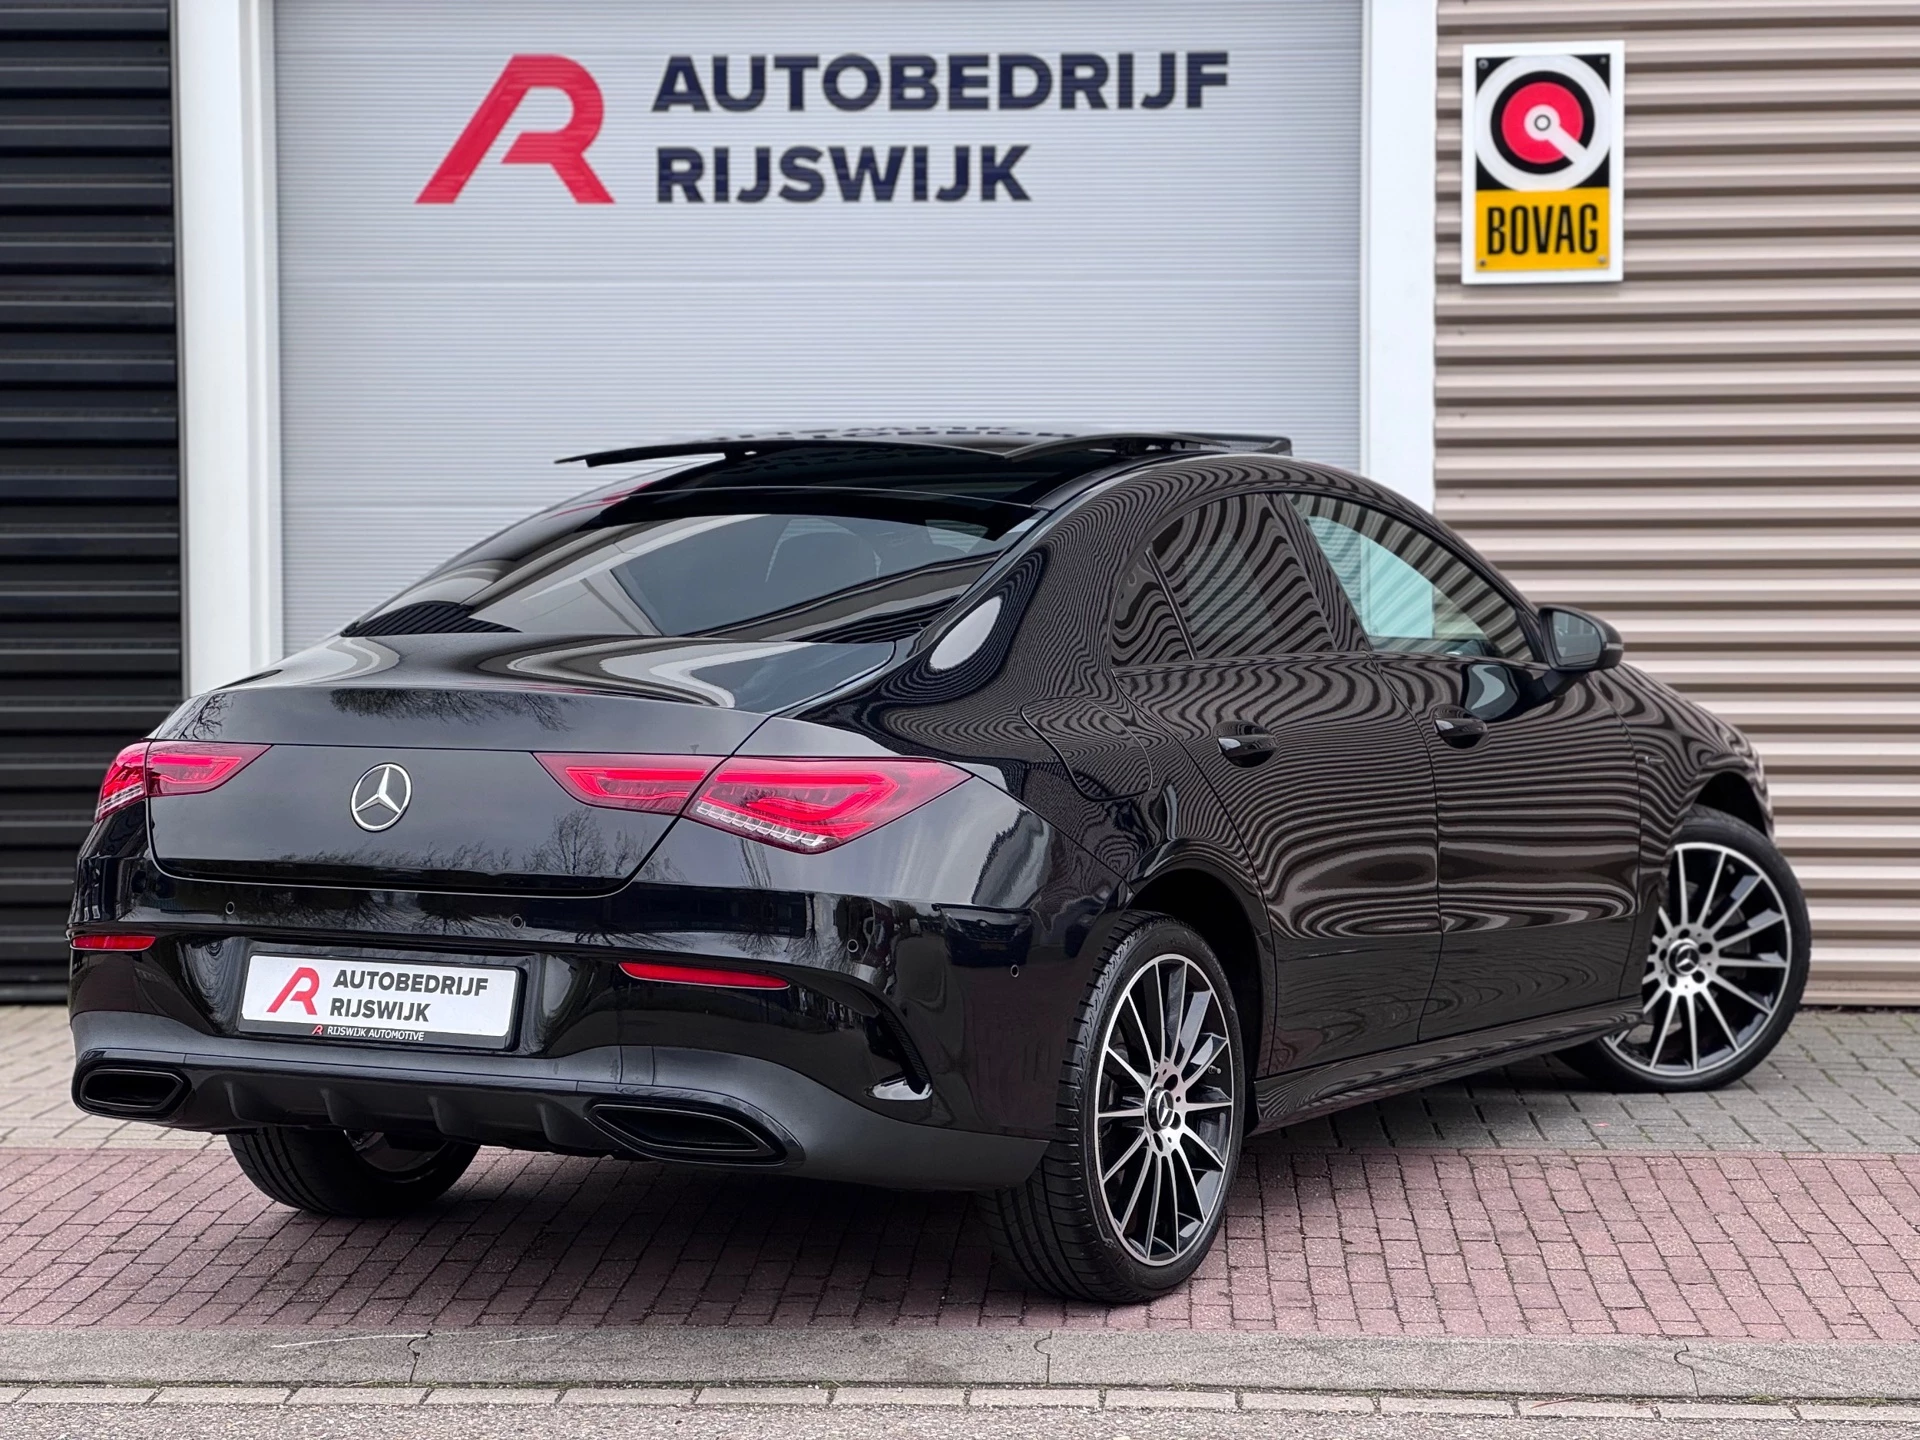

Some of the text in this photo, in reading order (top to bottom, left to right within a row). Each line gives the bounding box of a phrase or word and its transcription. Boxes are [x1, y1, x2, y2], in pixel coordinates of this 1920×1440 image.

[651, 51, 1230, 113] AUTOBEDRIJF
[656, 144, 1032, 203] RIJSWIJK
[1487, 203, 1599, 256] BOVAG
[333, 969, 488, 996] AUTOBEDRIJF
[329, 997, 432, 1023] RIJSWIJK
[327, 1025, 367, 1037] RIJSWIJK
[368, 1029, 425, 1041] AUTOMOTIVE
